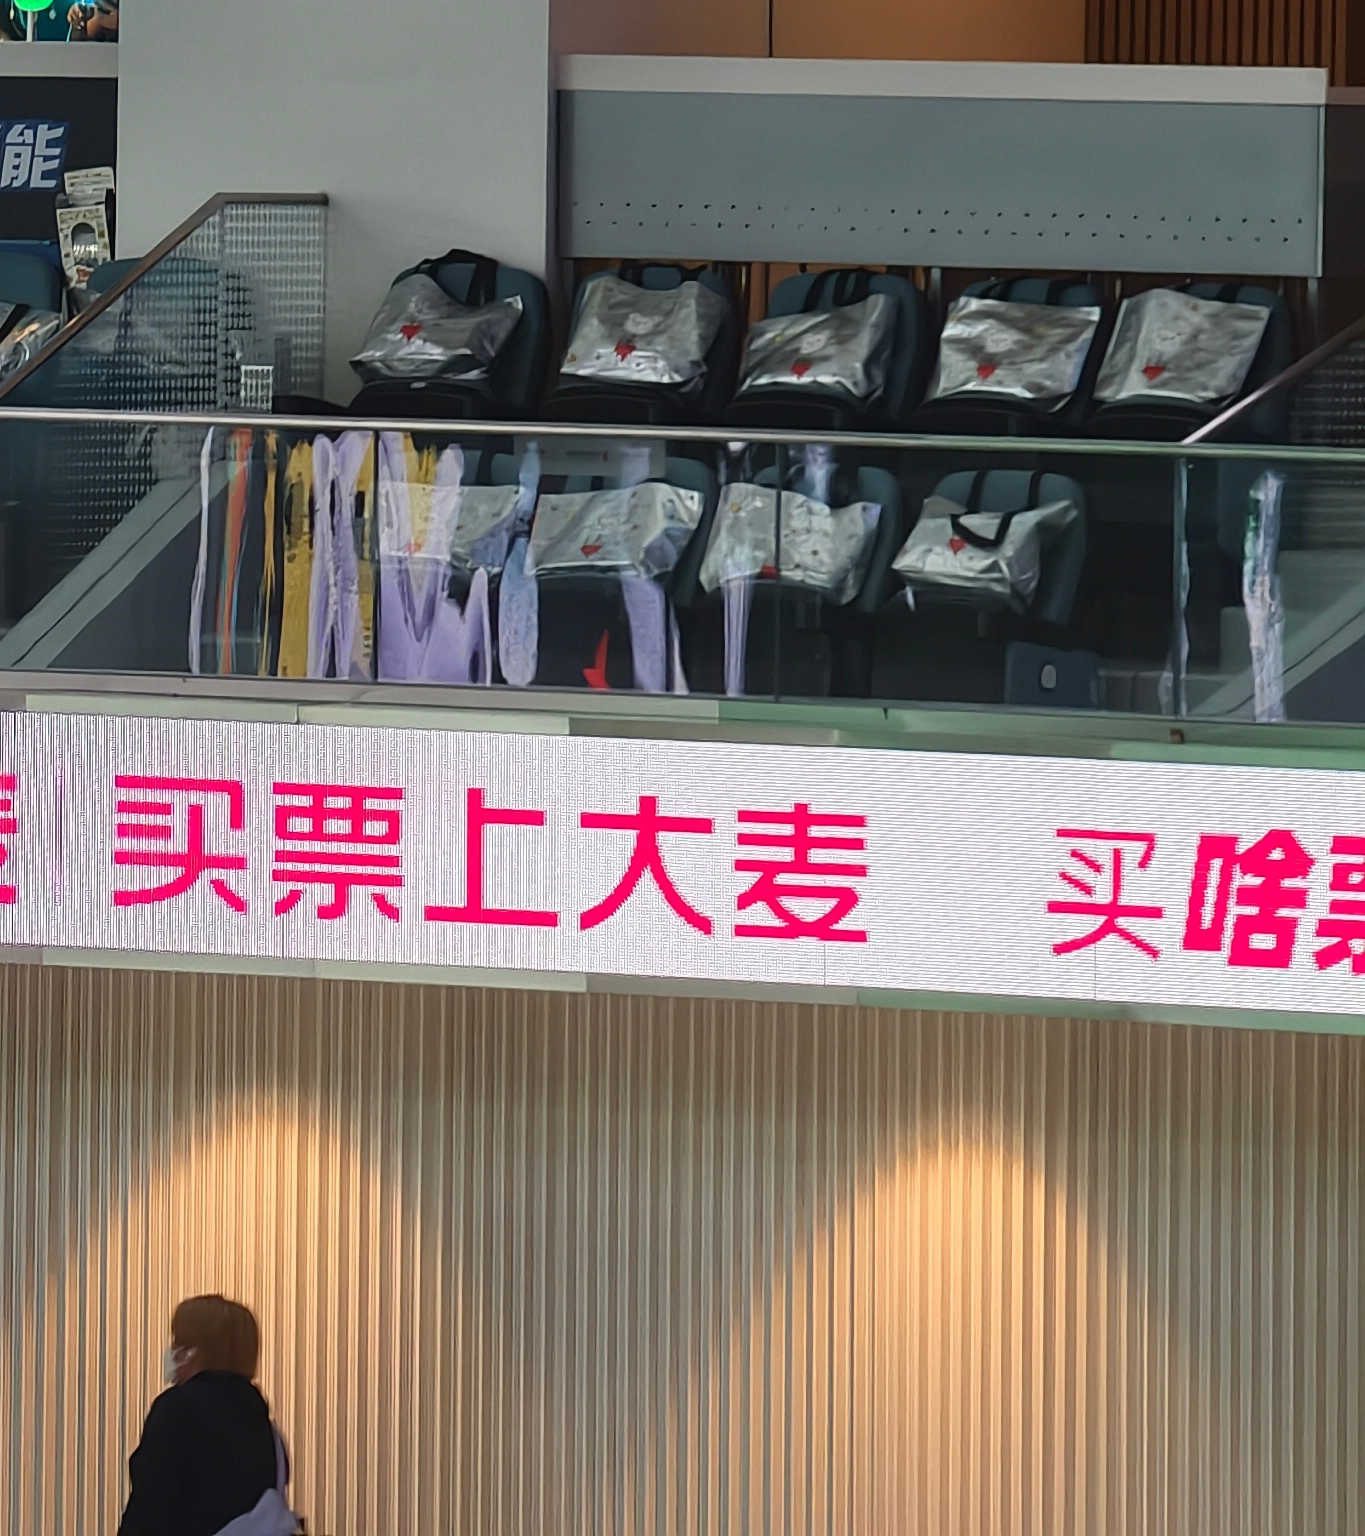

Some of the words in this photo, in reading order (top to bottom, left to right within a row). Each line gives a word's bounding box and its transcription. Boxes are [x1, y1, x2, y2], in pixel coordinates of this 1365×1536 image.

[113, 774, 869, 944] 买票上大麦
